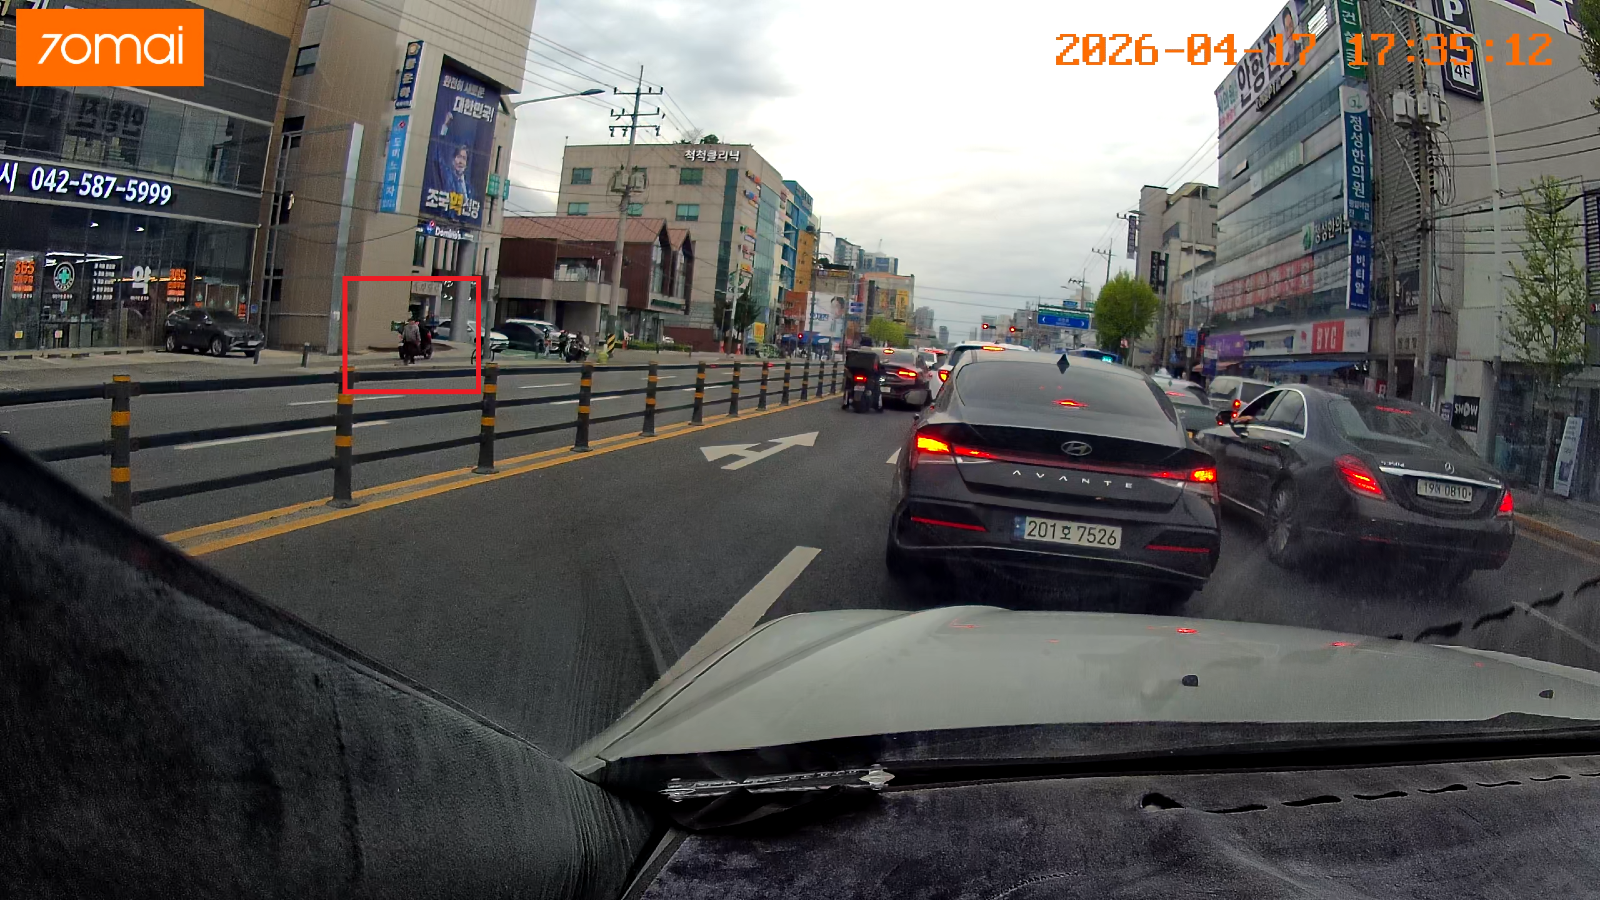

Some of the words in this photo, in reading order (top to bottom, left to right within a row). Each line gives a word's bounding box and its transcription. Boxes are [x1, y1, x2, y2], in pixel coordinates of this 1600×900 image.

[453, 96, 494, 122] 대한민국!
[385, 138, 401, 196] 도미노피자
[685, 149, 740, 162] 척척클리닉
[1350, 115, 1365, 198] 정성한의원
[32, 166, 172, 206] 042-587-5999
[426, 189, 480, 218] 조국혁신당
[1013, 470, 1132, 488] AVANTE
[1027, 520, 1071, 540] 201호
[1076, 525, 1117, 546] 7526
